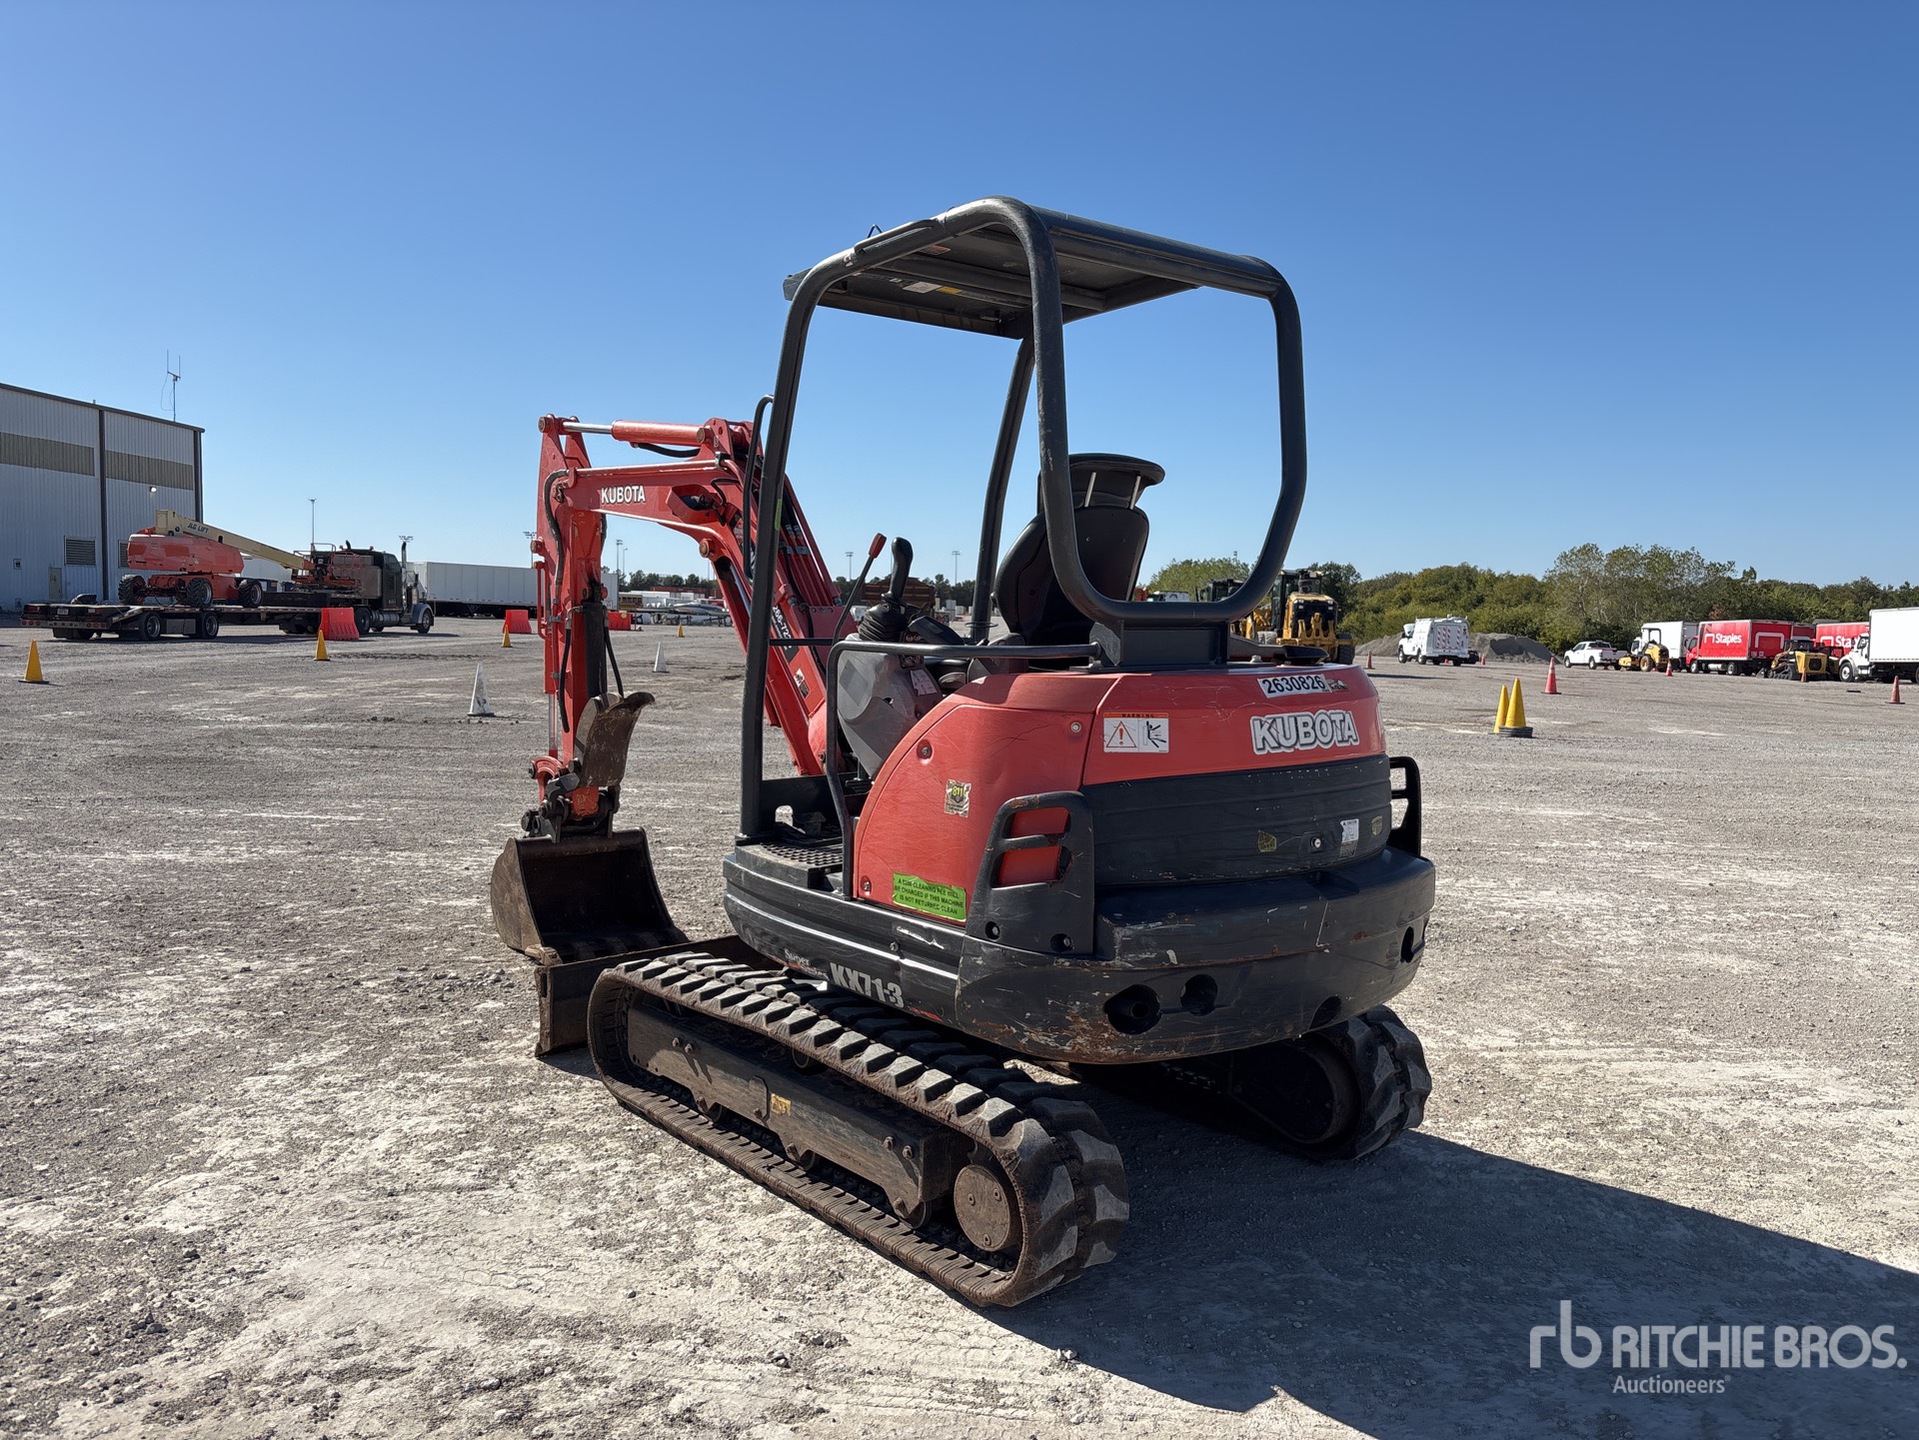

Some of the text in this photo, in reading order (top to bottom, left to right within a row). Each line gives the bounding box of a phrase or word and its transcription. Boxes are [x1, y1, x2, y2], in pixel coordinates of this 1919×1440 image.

[601, 486, 646, 503] KUBOTA
[1715, 634, 1742, 646] Staples
[1262, 675, 1326, 694] 2630826
[1250, 709, 1360, 755] KUBOTA
[952, 786, 963, 796] 811
[940, 897, 964, 908] MACHINE
[940, 905, 958, 914] CLEAN
[829, 962, 904, 1008] KX71-3
